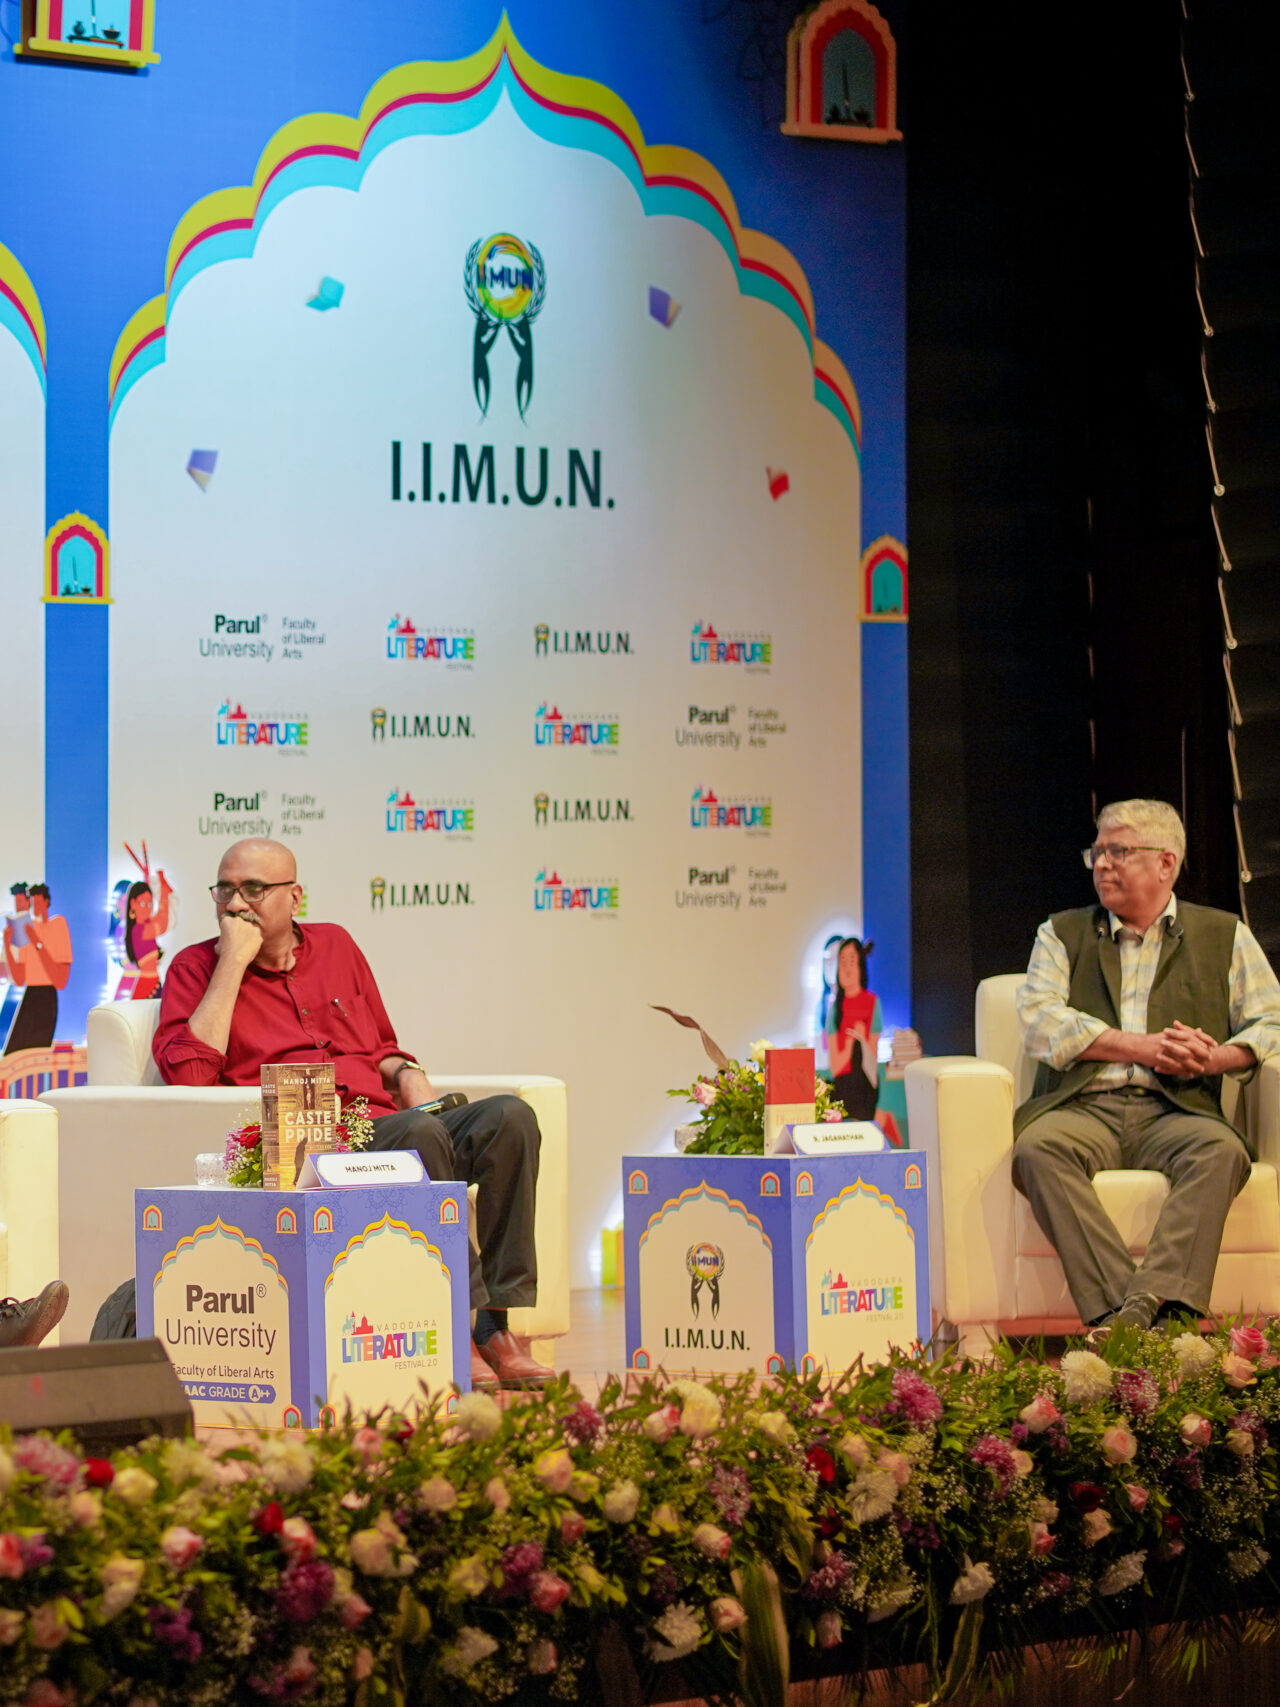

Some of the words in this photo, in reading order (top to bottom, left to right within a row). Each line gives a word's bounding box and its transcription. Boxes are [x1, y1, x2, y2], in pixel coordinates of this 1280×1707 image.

[391, 440, 615, 509] I.I.M.U.N.
[199, 638, 274, 662] University
[387, 636, 475, 660] LITERATURE
[553, 631, 635, 655] I.I.M.U.N.
[691, 641, 772, 664] LITERATURE
[216, 722, 308, 745] LITERATURE
[391, 715, 476, 738] I.I.M.U.N.
[535, 723, 619, 745] LITERATURE
[675, 729, 741, 751] University
[386, 808, 474, 832] LITERATURE
[553, 800, 634, 823] I.I.M.U.N.
[691, 806, 772, 828] LITERATURE
[198, 816, 273, 839] University
[390, 884, 475, 907] I.I.M.U.N.
[534, 887, 619, 910] LITERATURE
[675, 889, 741, 911] University
[283, 1077, 308, 1085] MANOJ
[311, 1076, 331, 1084] MITTA
[284, 1110, 332, 1125] CASTE
[285, 1127, 332, 1143] PRIDE
[345, 1165, 372, 1173] MANOJ
[373, 1164, 397, 1172] MITTA
[821, 1286, 904, 1315] LITERATURE
[166, 1318, 277, 1356] University
[377, 1319, 437, 1332] VADODARA
[342, 1329, 438, 1363] LITERATURE
[665, 1327, 751, 1351] I.I.M.U.N.
[206, 1365, 217, 1377] of
[218, 1365, 251, 1378] Liberal
[253, 1367, 275, 1379] Arts
[394, 1360, 426, 1370] FESTIVAL
[184, 1384, 206, 1397] AAC
[208, 1385, 246, 1399] GRADE
